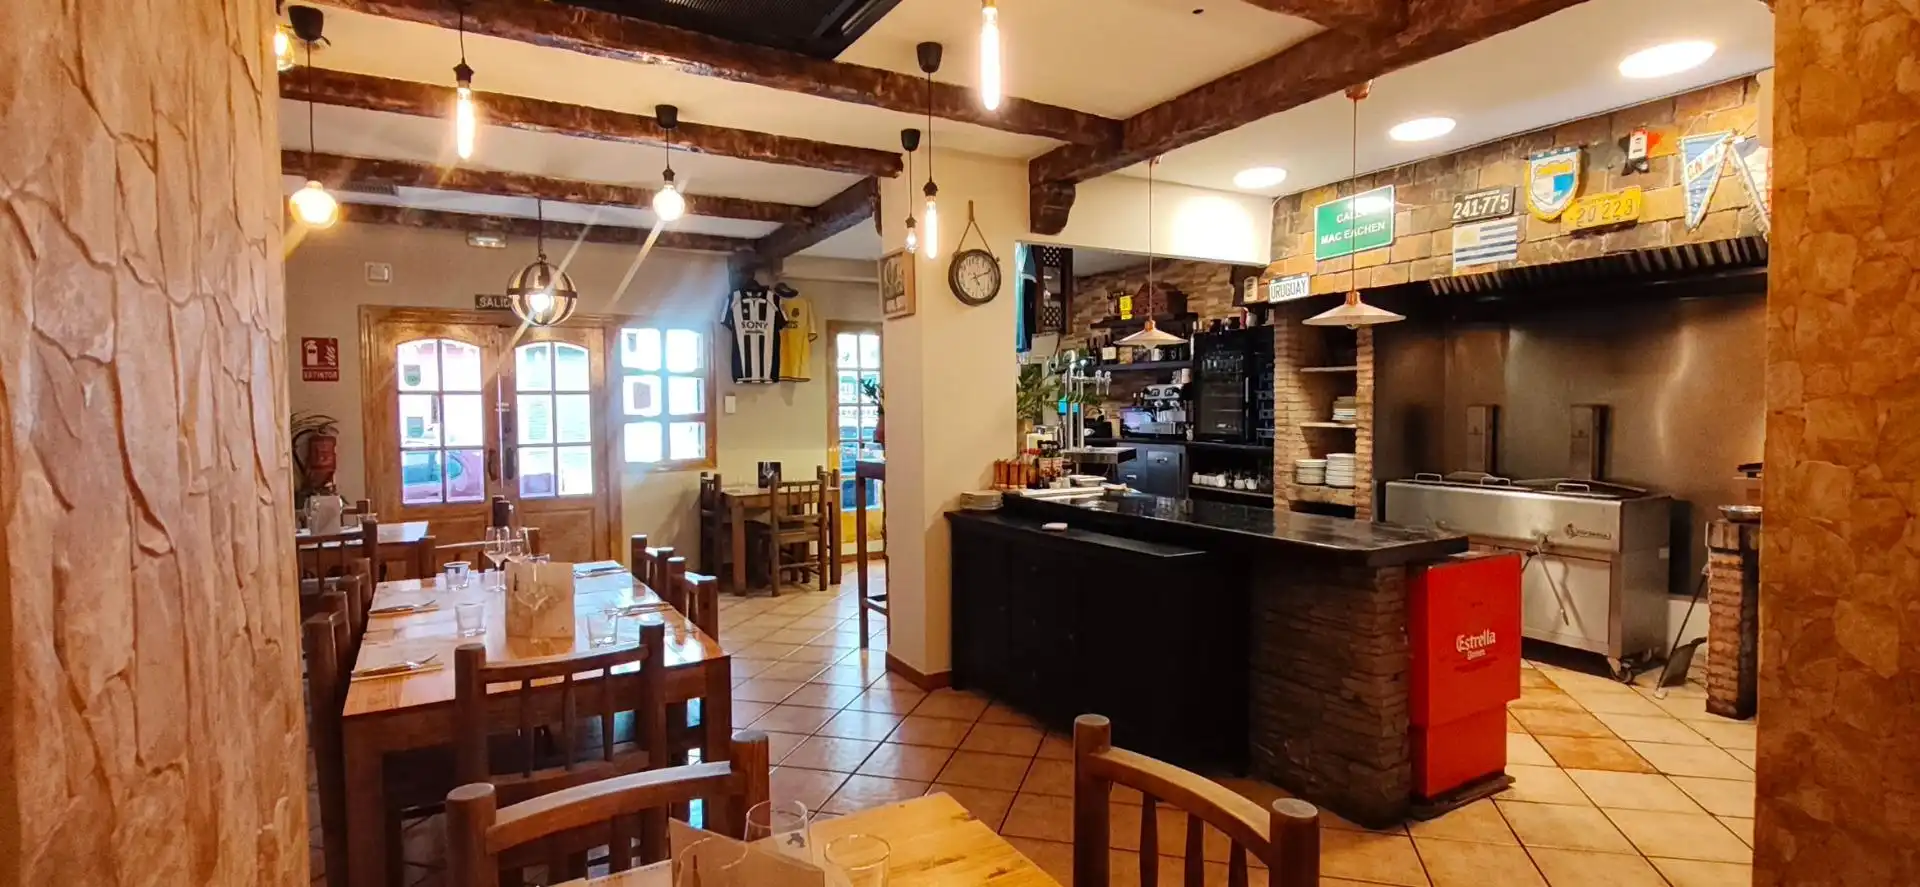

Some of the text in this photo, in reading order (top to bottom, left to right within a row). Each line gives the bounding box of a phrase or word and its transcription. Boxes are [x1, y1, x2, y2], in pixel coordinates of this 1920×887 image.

[1320, 221, 1386, 245] MAC EACHEN
[1270, 280, 1307, 300] URUGUAY
[741, 320, 768, 329] SONY
[1456, 628, 1496, 652] Estrella
